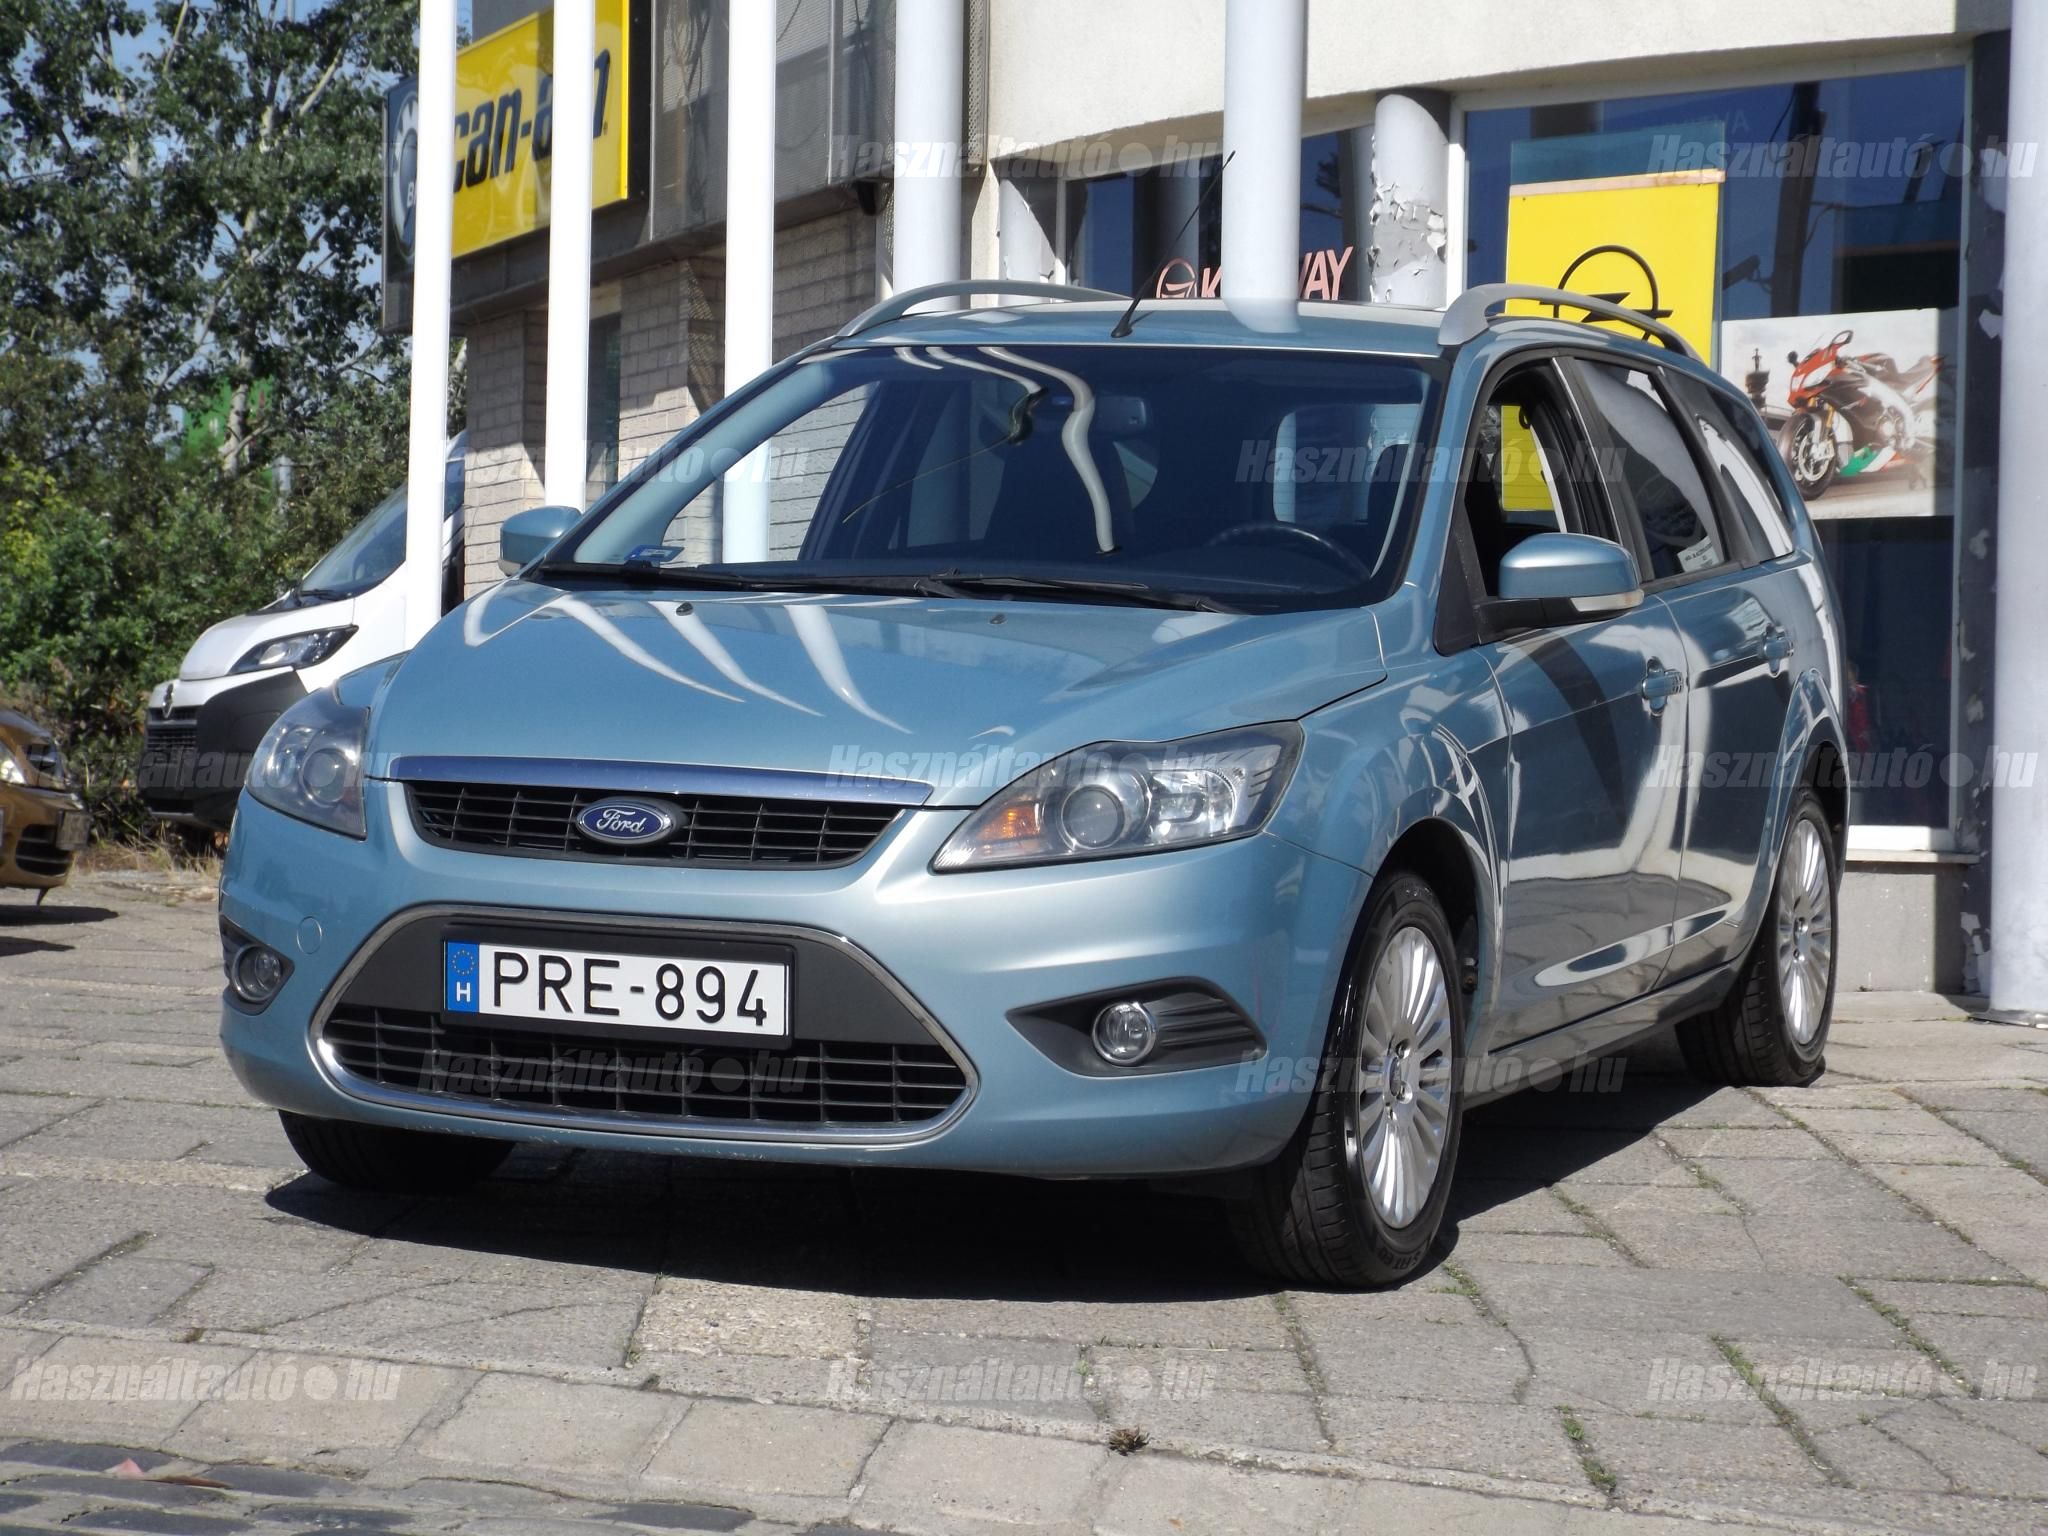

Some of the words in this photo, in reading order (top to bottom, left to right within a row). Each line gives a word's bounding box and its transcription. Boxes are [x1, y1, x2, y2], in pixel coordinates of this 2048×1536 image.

[596, 808, 648, 834] Ford
[456, 981, 471, 1003] H
[493, 951, 768, 1026] PRE-894
